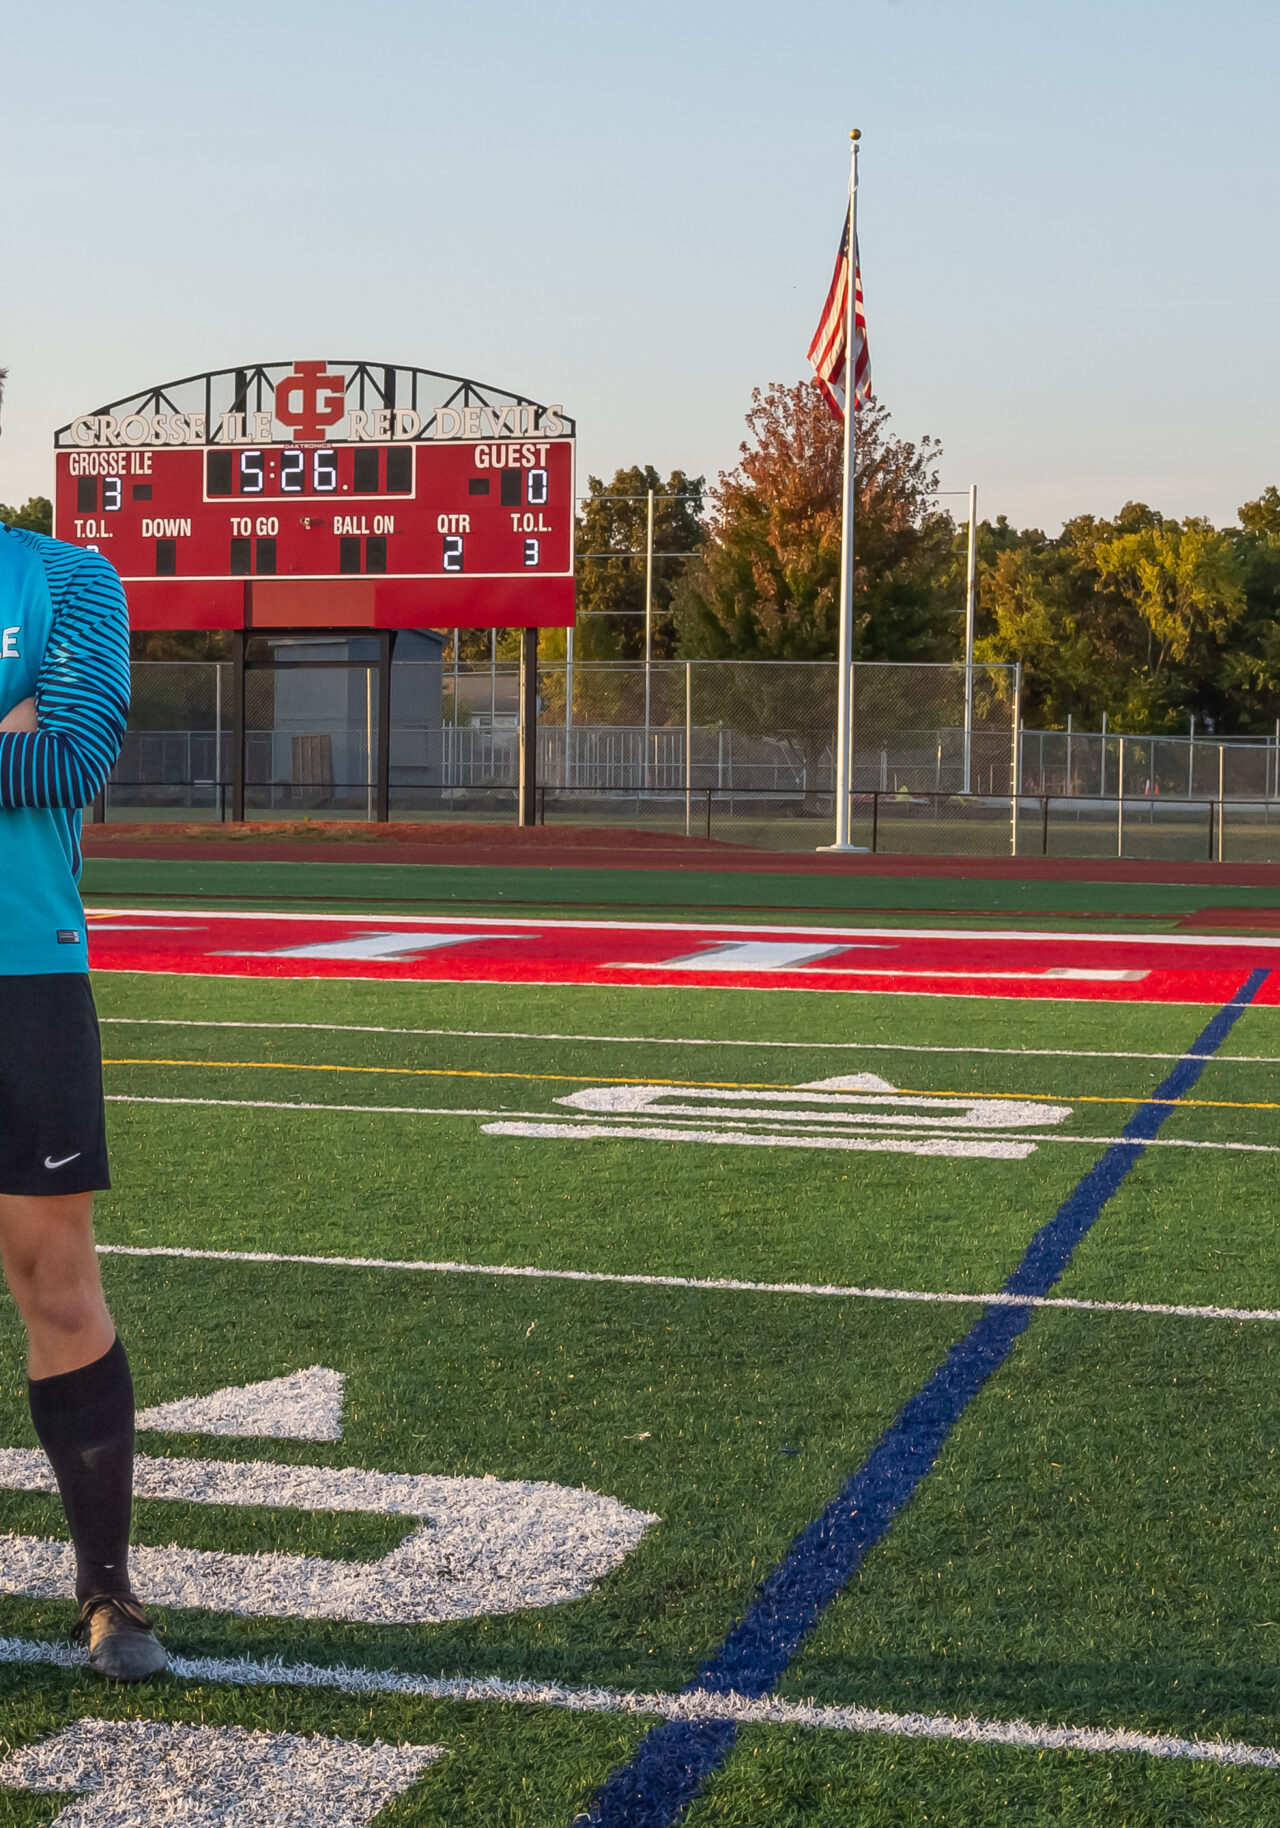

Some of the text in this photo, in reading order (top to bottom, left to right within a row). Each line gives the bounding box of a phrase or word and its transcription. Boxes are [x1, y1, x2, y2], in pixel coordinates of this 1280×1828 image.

[70, 411, 273, 447] GROSSE ILE
[347, 405, 564, 441] RED DEVILS
[69, 452, 152, 475] GROSSE ILE
[474, 444, 550, 468] GUEST
[104, 477, 121, 510] 3
[527, 469, 547, 503] 0
[74, 520, 113, 538] T.O.L.
[142, 518, 191, 537] DOWN
[230, 516, 279, 536] TO GO
[333, 515, 394, 535] BALL ON
[437, 514, 470, 533] QTR
[510, 513, 552, 532] T.O.L.
[443, 536, 463, 570] 2
[525, 538, 539, 566] 3
